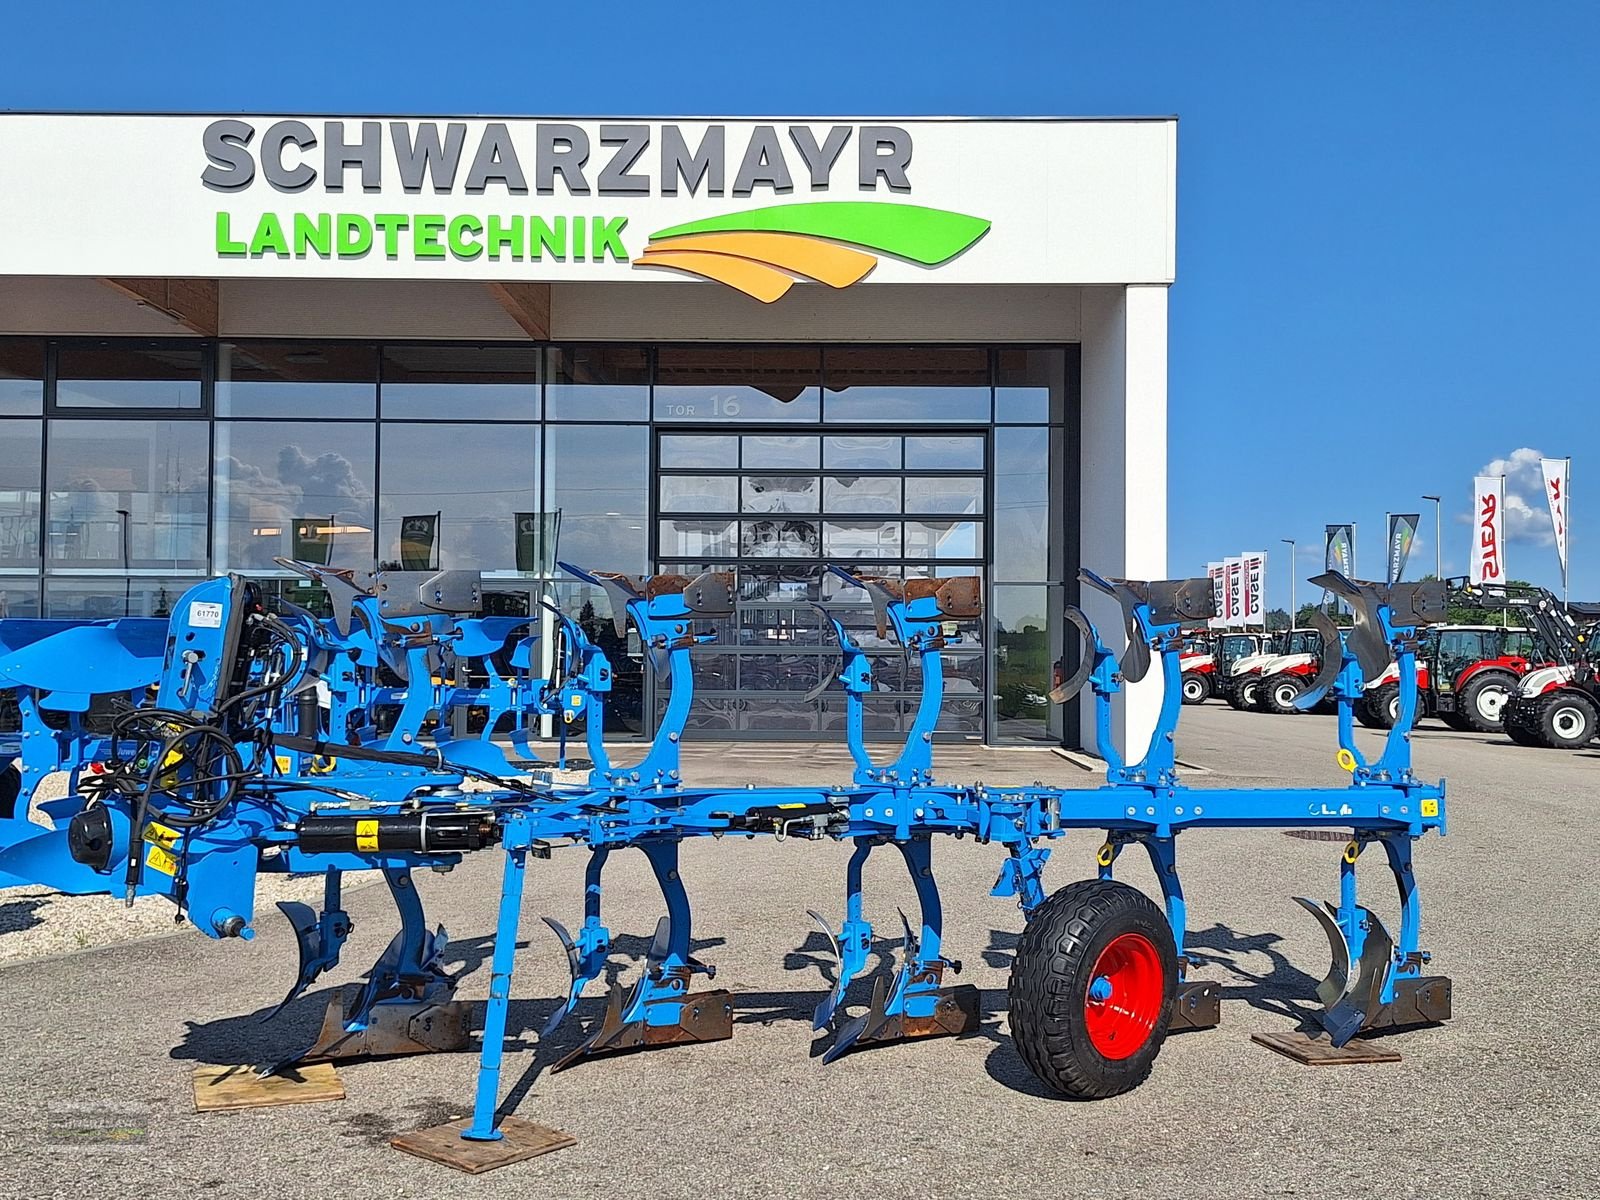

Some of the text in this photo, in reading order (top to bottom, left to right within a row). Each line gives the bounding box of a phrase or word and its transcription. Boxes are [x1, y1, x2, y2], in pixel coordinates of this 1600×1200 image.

[201, 119, 913, 198] SCHWARZMAYR
[215, 211, 630, 262] LANDTECHNIK
[666, 394, 740, 416] TOR 16
[1391, 532, 1402, 584] WARZMAYR
[197, 609, 219, 618] 61770
